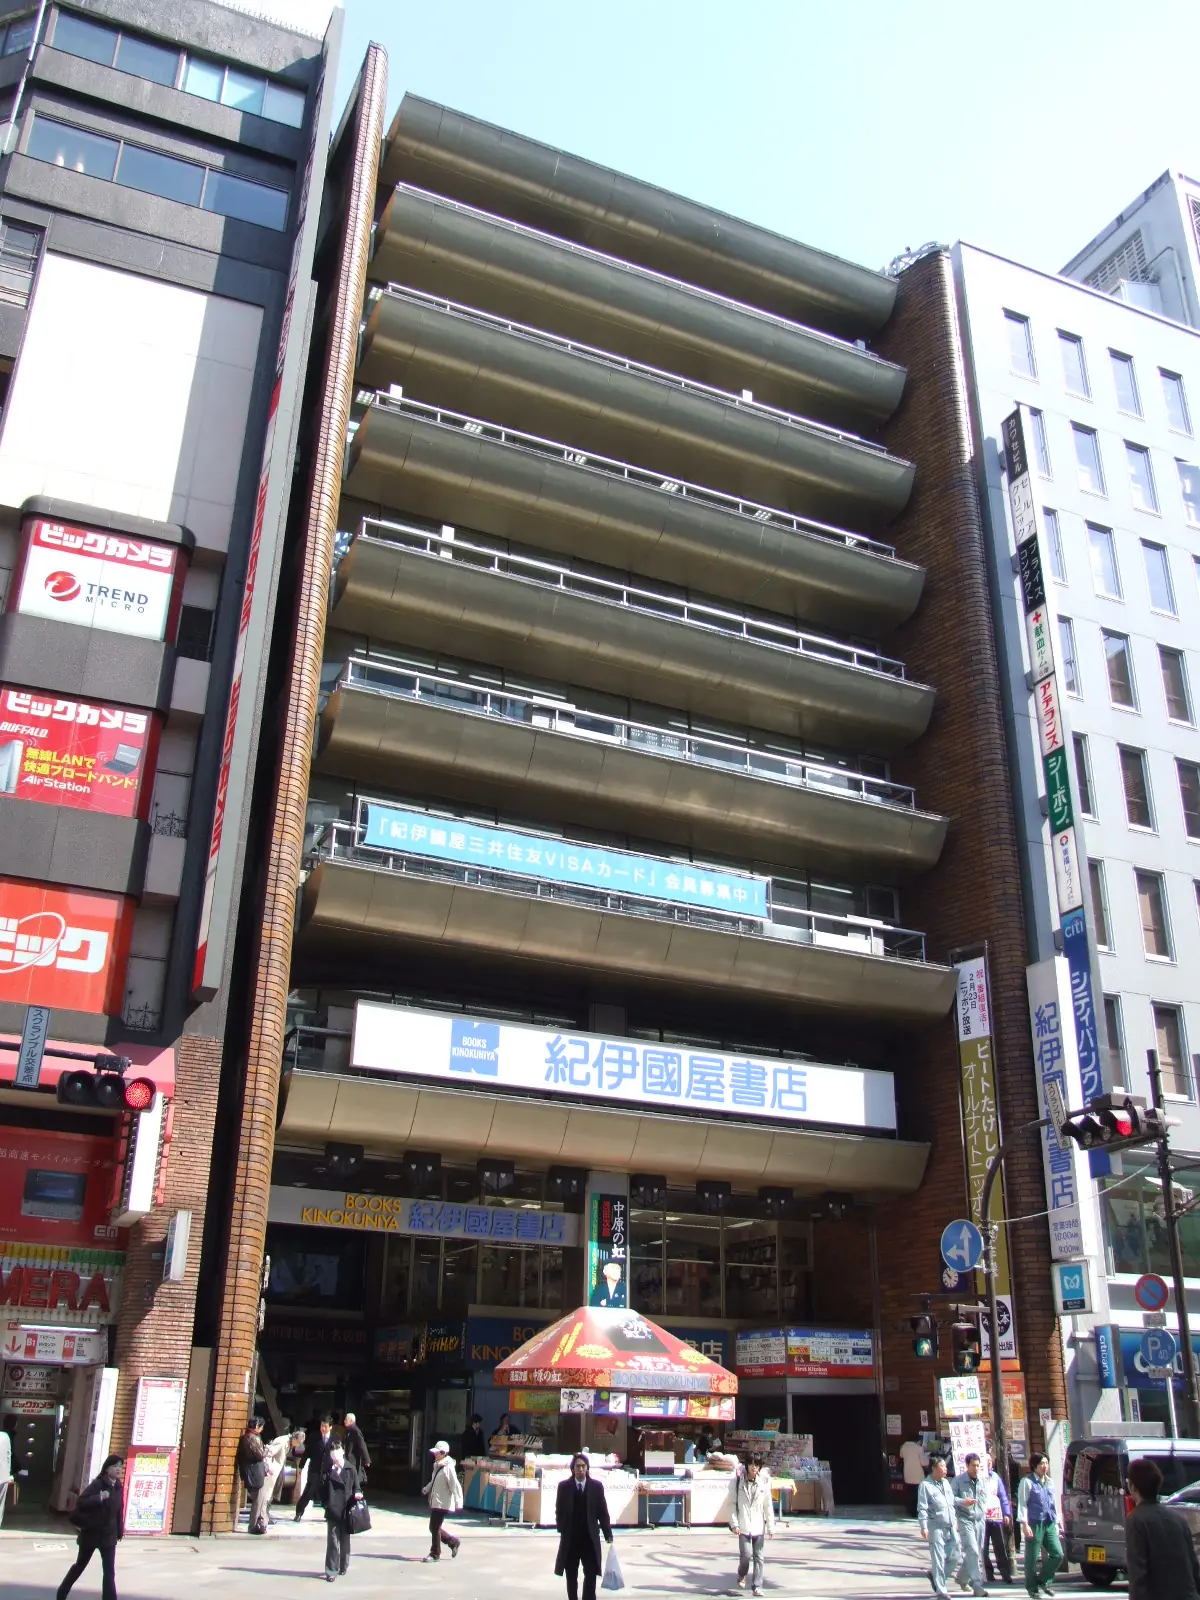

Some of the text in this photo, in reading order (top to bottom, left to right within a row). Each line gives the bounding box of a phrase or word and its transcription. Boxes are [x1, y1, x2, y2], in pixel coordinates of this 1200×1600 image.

[40, 522, 173, 568] ビックカメラ
[85, 596, 145, 613] MICRO
[87, 583, 149, 605] TREND
[6, 690, 148, 734] ビックカメラ
[1040, 681, 1059, 751] アデランス
[0, 722, 49, 738] BUFFALO
[25, 747, 96, 770] 無線LANで
[22, 776, 91, 795] AirStation
[1064, 920, 1084, 938] citi
[960, 981, 972, 1036] ニッポン放送
[462, 1036, 487, 1048] BOOKS
[452, 1046, 495, 1061] KINOKUNIYA
[544, 1034, 807, 1112] 紀伊國屋書店
[345, 1193, 401, 1214] BOOKS
[302, 1208, 399, 1231] KINOKUNIYA
[409, 1201, 566, 1242] 紀伊國屋書店
[611, 1201, 626, 1259] 中原の虹
[983, 1342, 1014, 1351] 太出版
[11, 1400, 55, 1409] ビックカメラ
